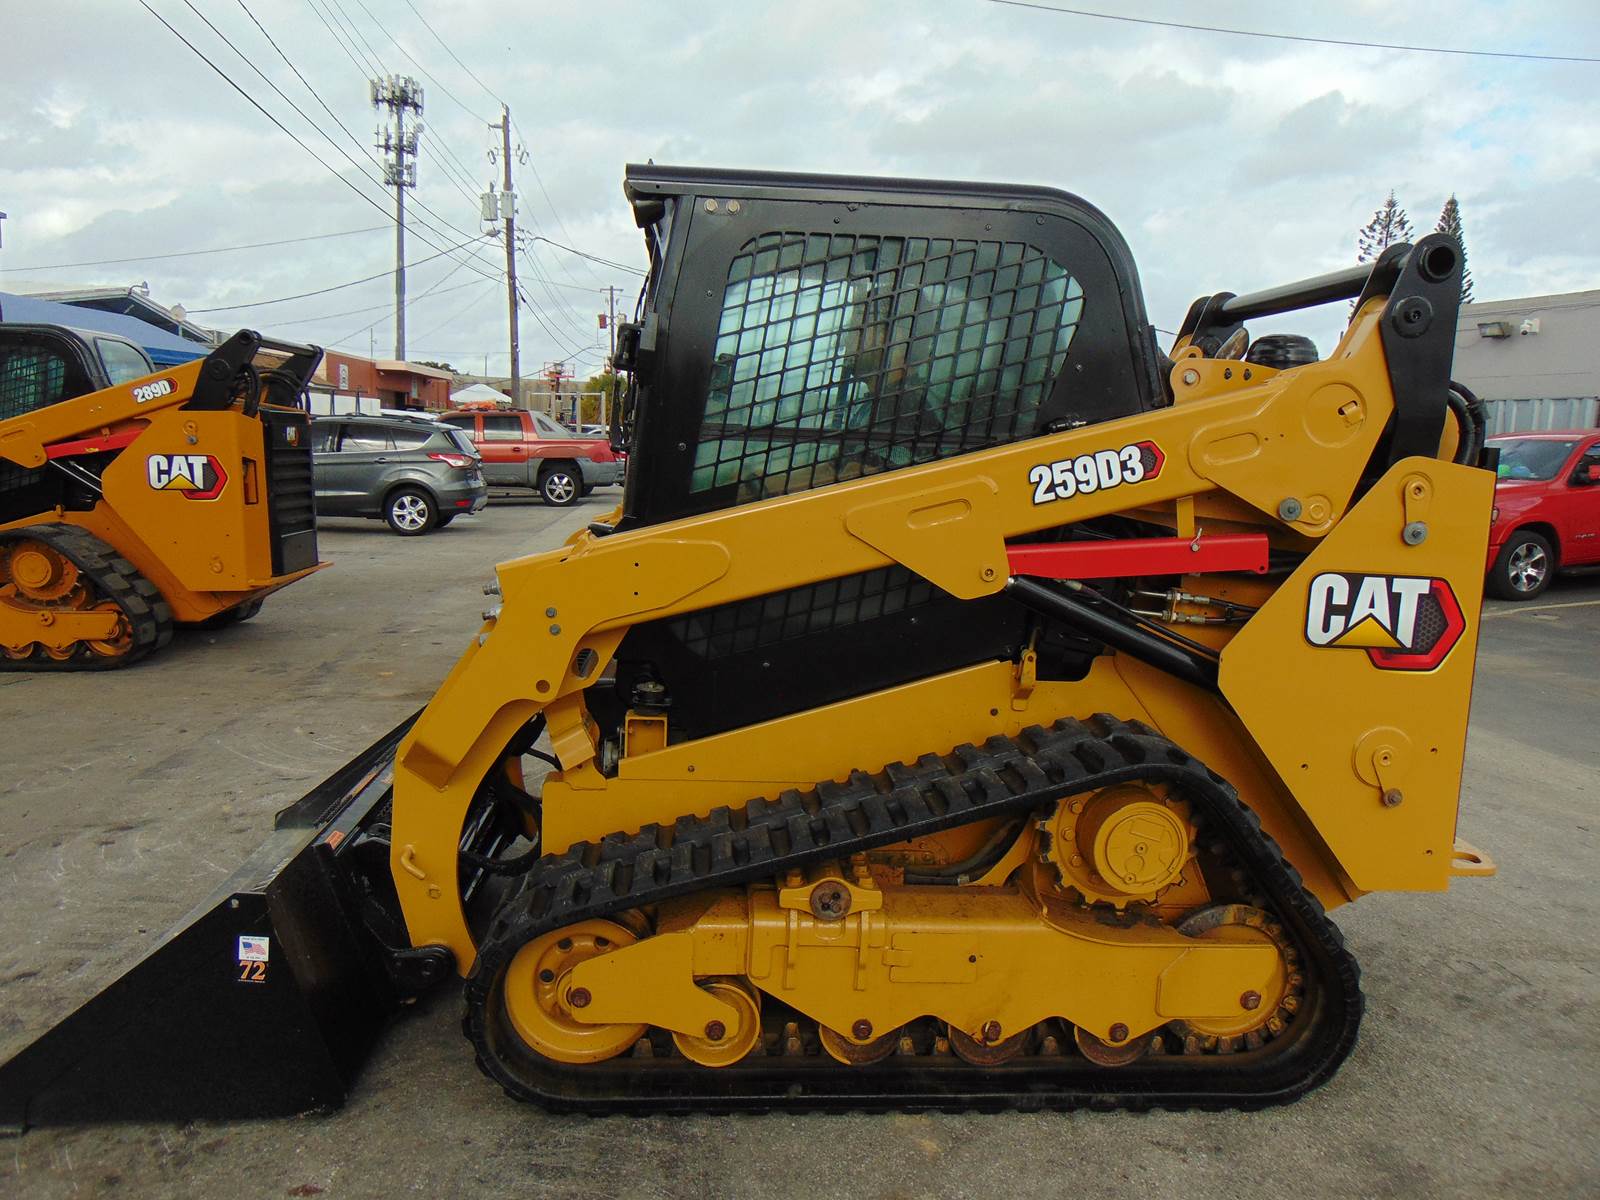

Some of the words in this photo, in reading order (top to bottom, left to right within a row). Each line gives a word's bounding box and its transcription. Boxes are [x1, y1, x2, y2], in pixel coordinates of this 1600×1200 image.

[133, 378, 171, 403] 289D
[148, 455, 207, 490] CAT
[1029, 445, 1145, 504] 259D3
[1306, 573, 1431, 649] CAT
[240, 960, 266, 980] 72
